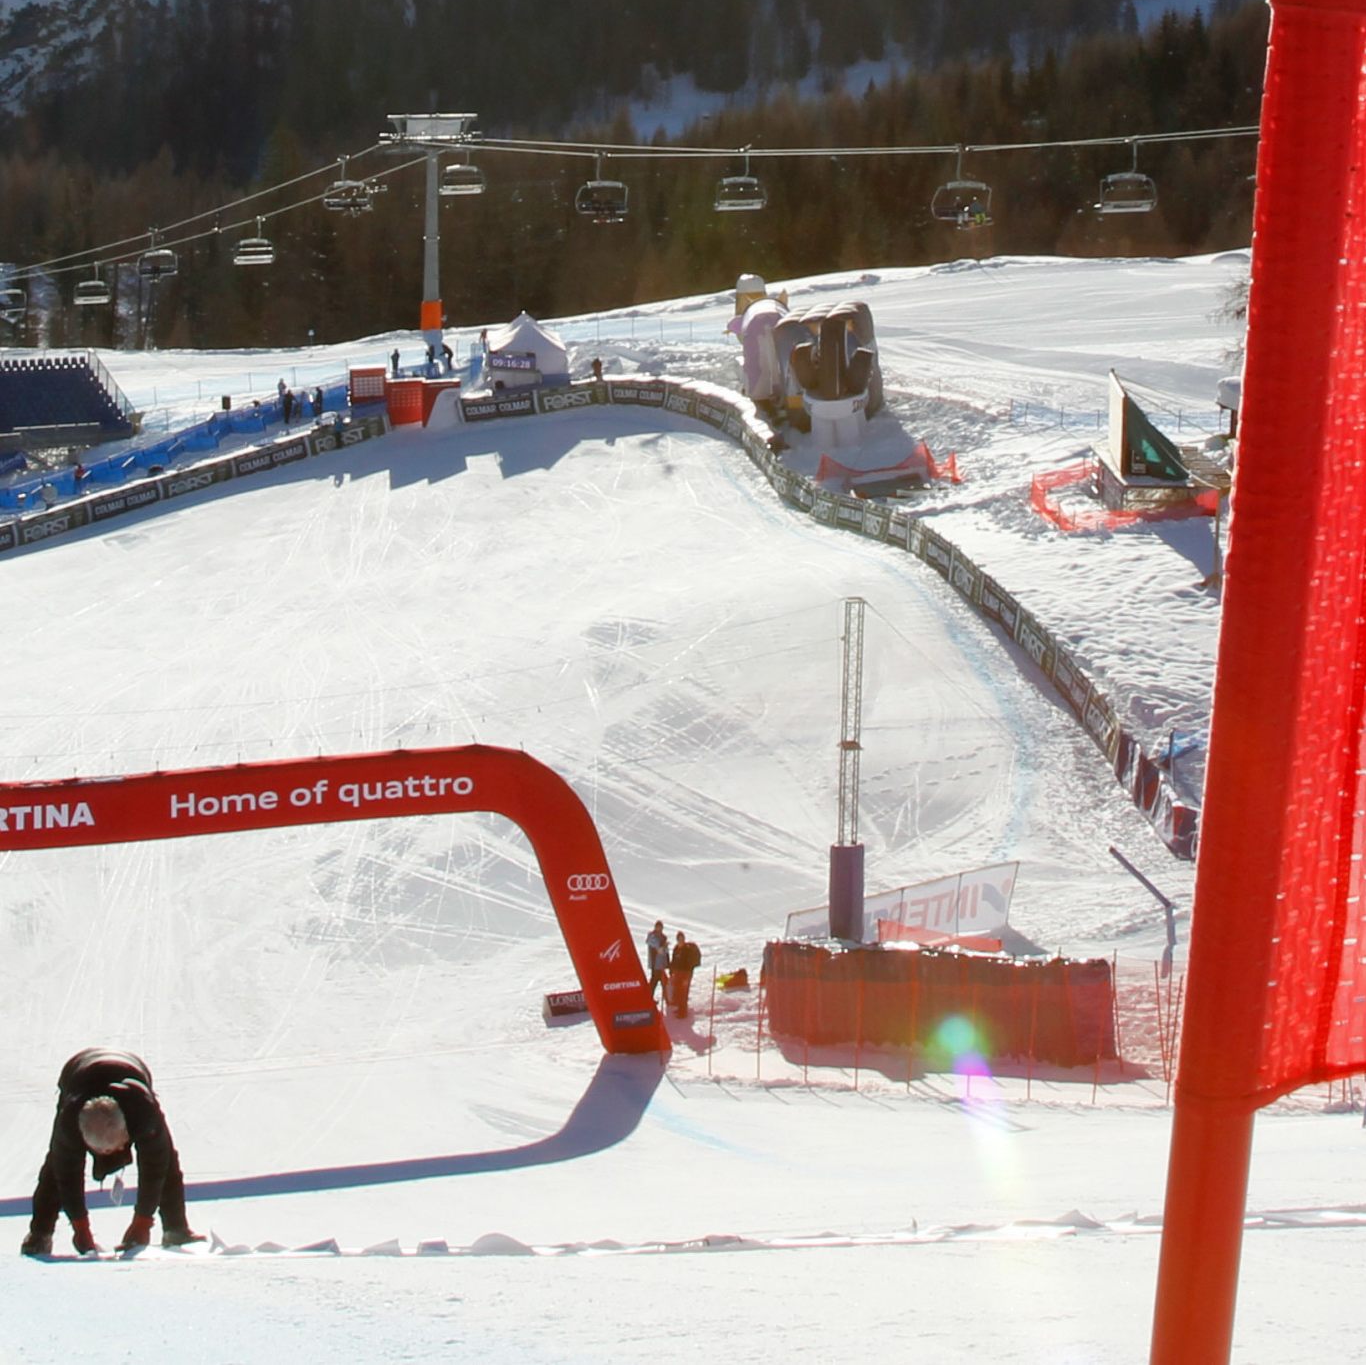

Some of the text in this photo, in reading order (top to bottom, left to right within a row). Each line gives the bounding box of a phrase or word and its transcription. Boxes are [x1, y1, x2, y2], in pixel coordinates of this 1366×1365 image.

[492, 358, 530, 369] 09:16:28
[465, 400, 531, 416] COLMAR COLMAR
[543, 390, 593, 411] FORST
[315, 426, 365, 452] FOST
[239, 445, 304, 472] COLMAR COLMAR
[168, 472, 214, 496] FORST
[95, 489, 157, 516] COLMAR COLMAR
[24, 515, 71, 542] FORST
[170, 775, 474, 818] Home of quattro
[604, 981, 640, 991] CORTINA
[551, 993, 586, 1007] LONGI
